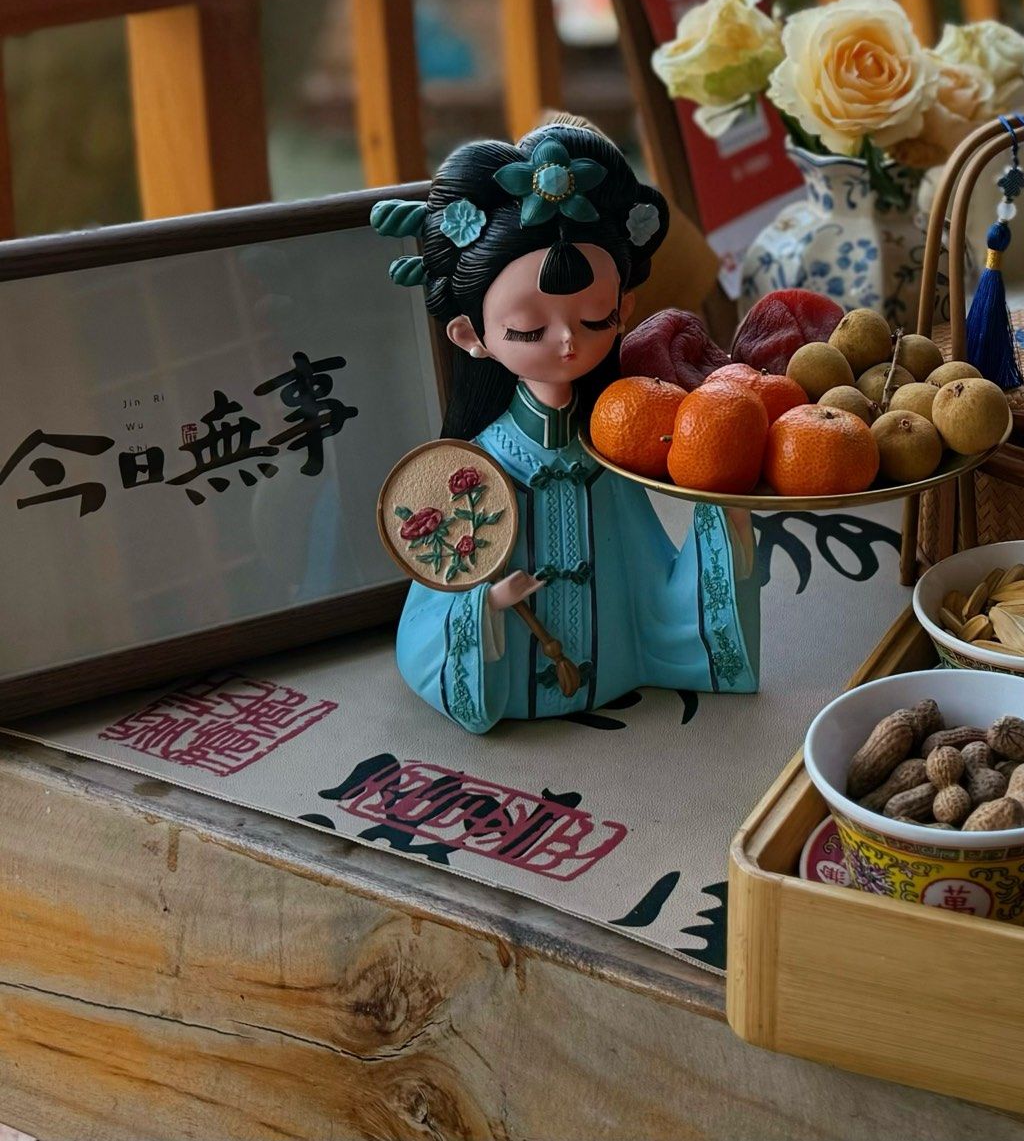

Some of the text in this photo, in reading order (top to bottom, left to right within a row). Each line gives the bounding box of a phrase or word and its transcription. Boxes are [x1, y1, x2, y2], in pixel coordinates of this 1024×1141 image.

[123, 393, 164, 409] Jin Ri
[0, 351, 358, 517] 今日無事
[125, 422, 143, 431] Wu
